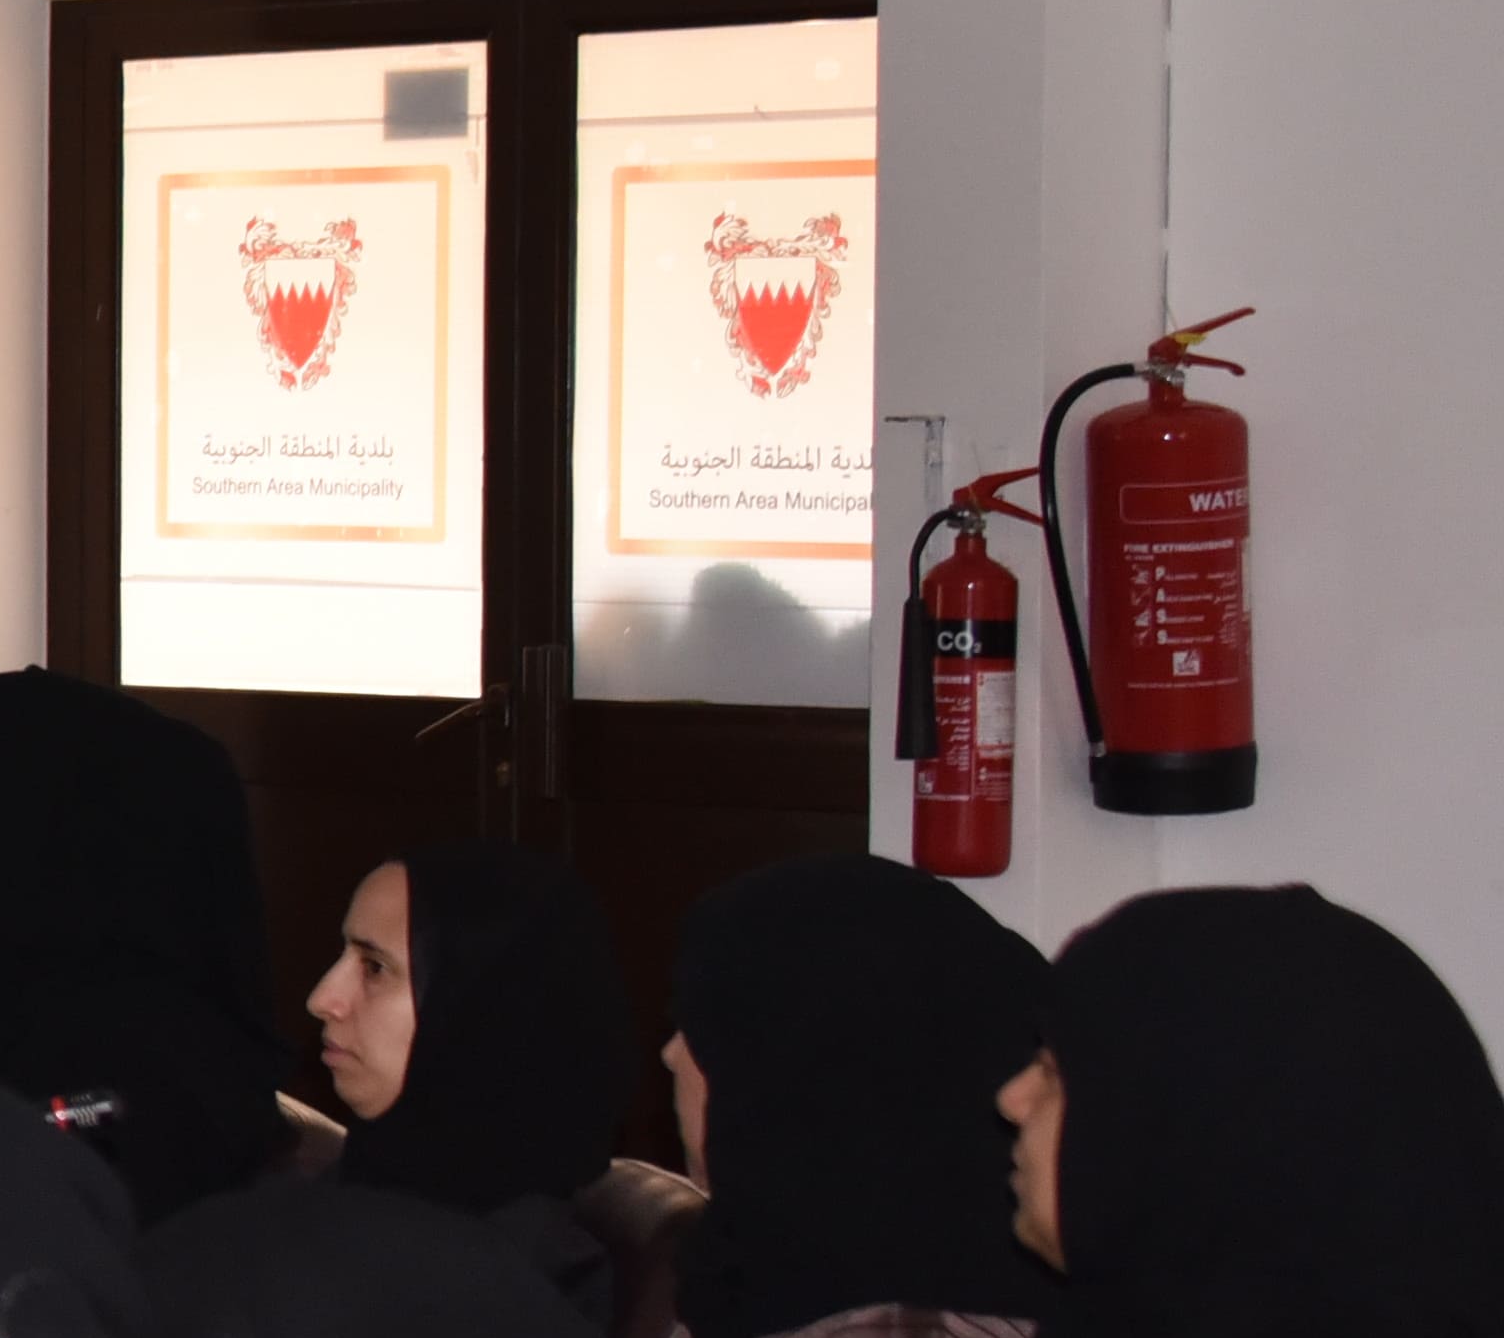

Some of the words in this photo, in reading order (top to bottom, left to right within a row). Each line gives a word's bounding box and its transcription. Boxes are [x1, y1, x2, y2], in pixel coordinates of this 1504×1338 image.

[202, 433, 271, 465] الجنوبية
[279, 434, 340, 460] المنطقة
[348, 434, 394, 466] بلدية
[661, 444, 741, 477] الجنوبية
[750, 444, 821, 472] المنطقة
[192, 476, 262, 495] Southern
[266, 477, 304, 496] Area
[309, 477, 404, 501] Municipality
[649, 488, 730, 510] Southern
[735, 490, 778, 511] Area
[785, 490, 873, 516] Municipal
[1189, 487, 1247, 512] WATE
